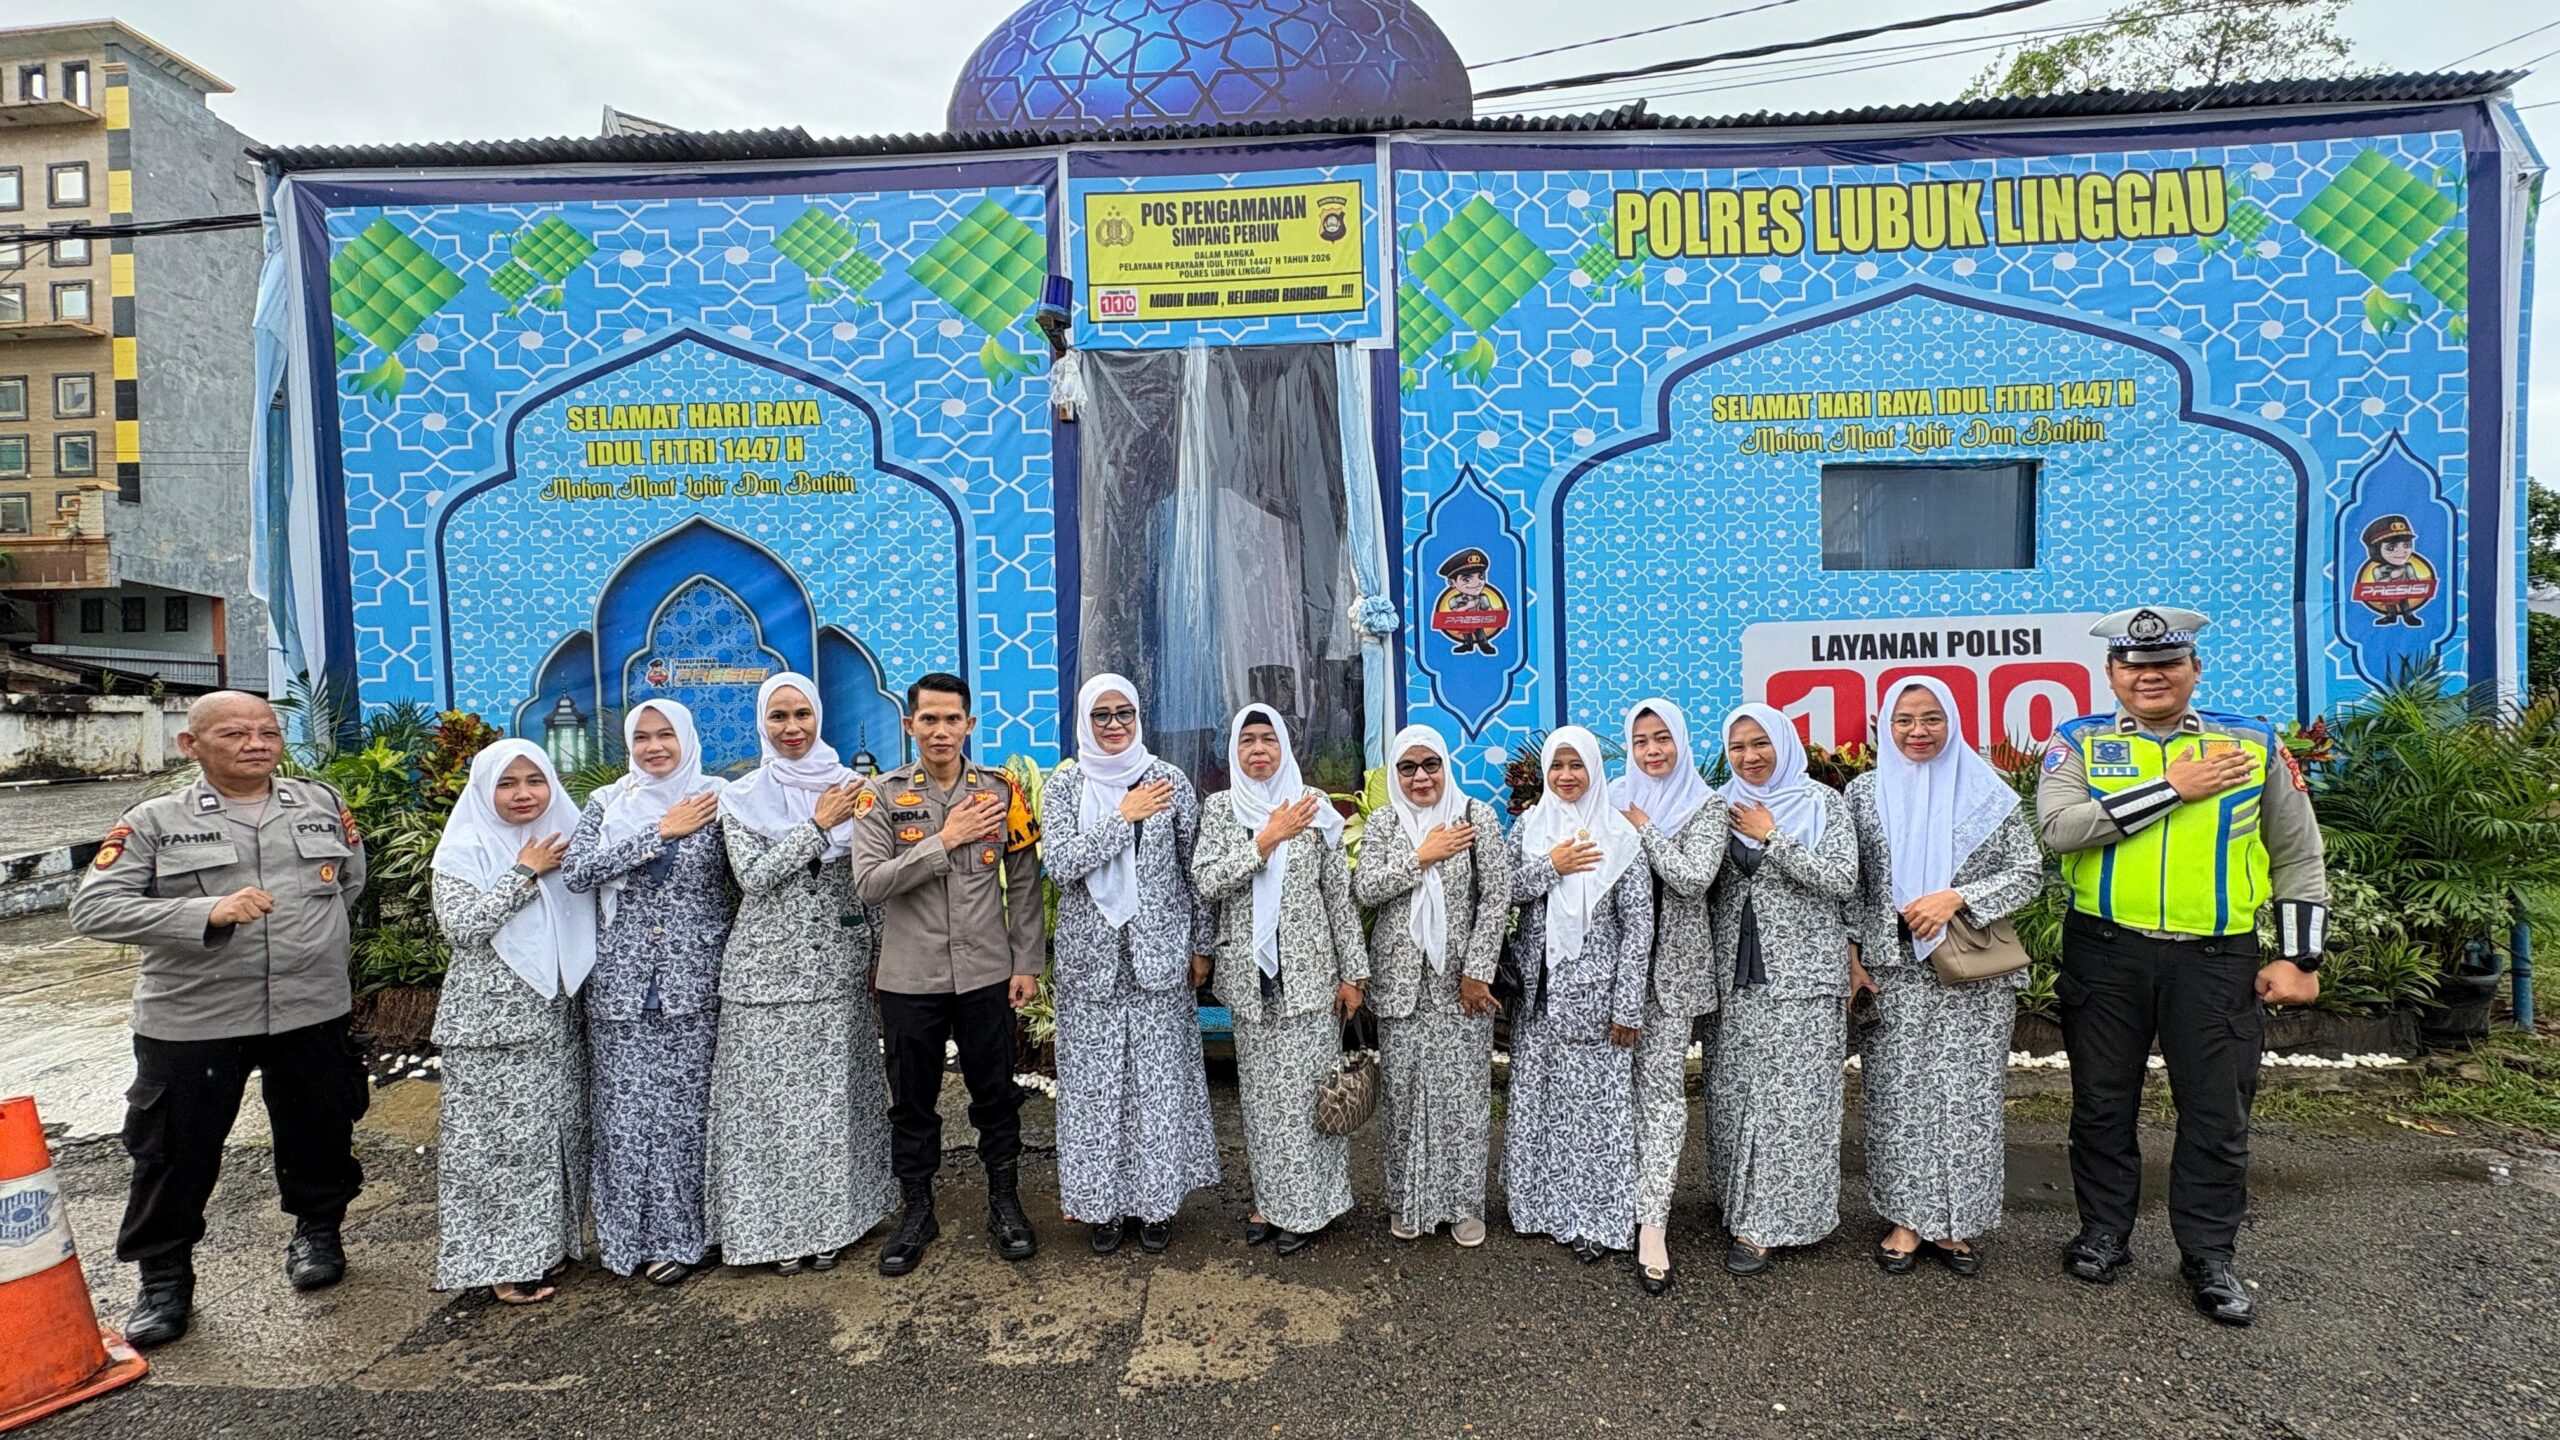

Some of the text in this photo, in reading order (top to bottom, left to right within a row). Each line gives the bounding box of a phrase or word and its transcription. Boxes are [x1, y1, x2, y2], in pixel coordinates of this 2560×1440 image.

[1141, 201, 1178, 226] POS
[1182, 195, 1307, 225] PENGAMANAN
[1613, 166, 2228, 260] POLRES LUBUK LINGGAU
[1172, 223, 1280, 247] SIMPANG PERIUK
[1119, 254, 1331, 271] PELAYANAN PERAYAAN IDUL FITRI 14447 H TAHUN 2026
[1194, 249, 1255, 259] DALAM RANGKA
[1179, 266, 1271, 278] POLRES LUBUK LINGGAU
[1101, 297, 1136, 311] 110
[1149, 293, 1184, 308] MUDIK
[1187, 291, 1219, 307] AMAN
[1227, 288, 1279, 305] KELUARGA
[1712, 379, 2136, 423] SELAMAT HARI RAYA IDUL FITRI 1447 H
[566, 399, 823, 432] SELAMAT HARI RAYA
[1739, 415, 2108, 456] Mohon Maaf Lahir Dan Bathin
[586, 435, 805, 467] IDUL FITRI 1447 H
[540, 470, 858, 503] Mohon Maaf Lahir Dan Bathin
[2360, 583, 2431, 597] PRESISI
[1444, 615, 1498, 625] PRESISI
[1811, 627, 2042, 662] LAYANAN POLISI
[2097, 767, 2132, 776] ULI
[160, 831, 222, 847] FAHMI
